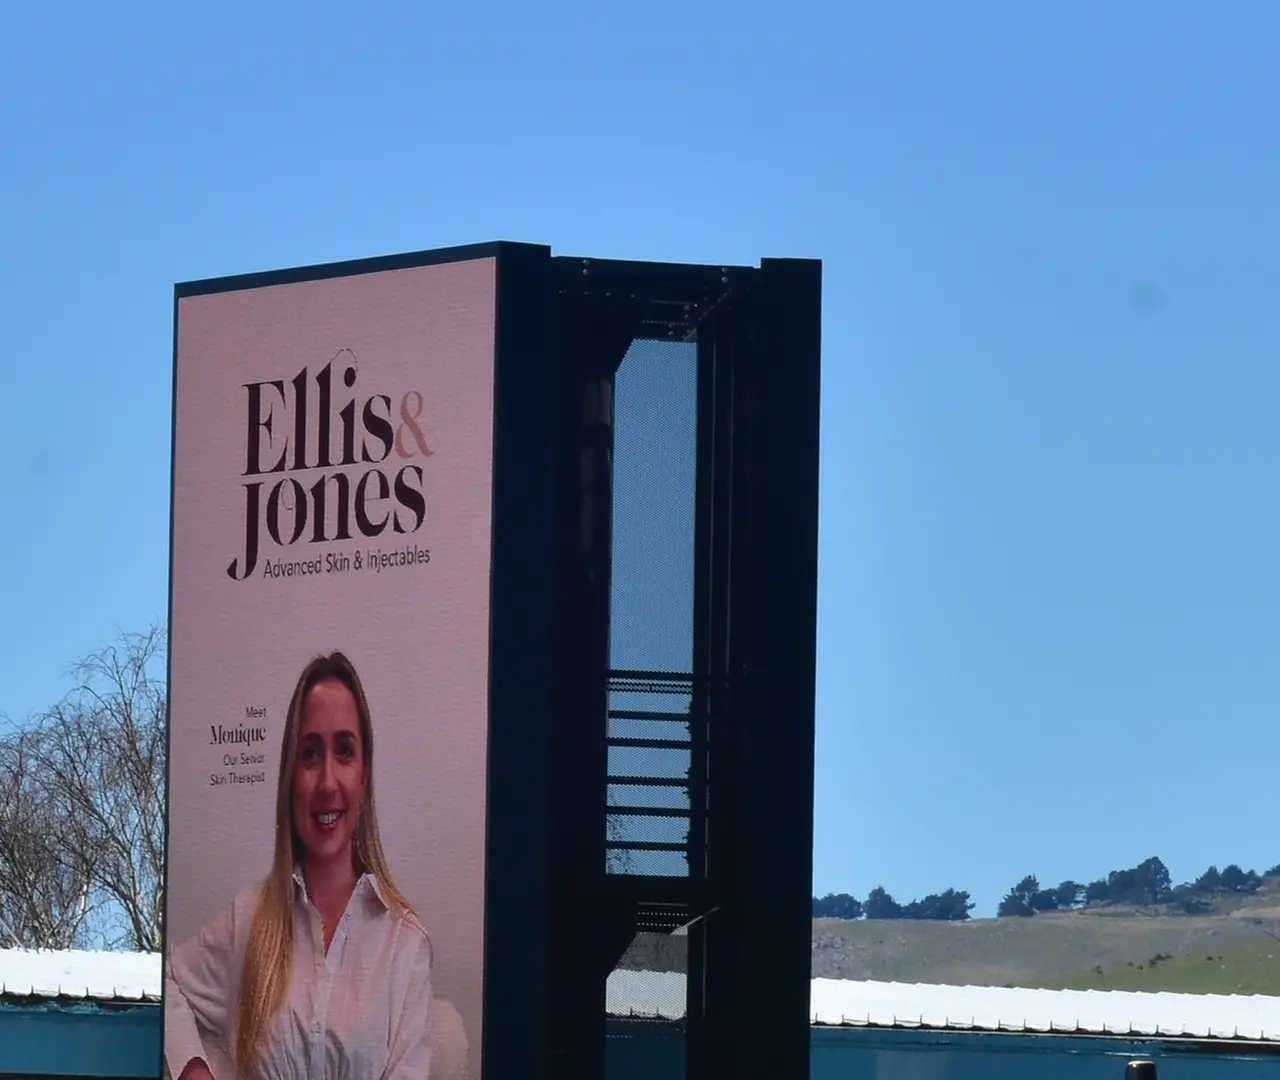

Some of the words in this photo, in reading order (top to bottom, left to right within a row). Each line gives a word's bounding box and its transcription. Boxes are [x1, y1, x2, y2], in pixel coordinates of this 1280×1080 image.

[227, 465, 426, 581] Jones
[263, 554, 321, 579] Advanced
[325, 551, 350, 573] Skin
[353, 550, 363, 571] &
[366, 545, 430, 574] Injectables
[245, 706, 267, 718] Meet
[210, 723, 267, 748] Monique
[223, 753, 238, 766] Our
[210, 773, 227, 786] Skin
[229, 772, 265, 785] Therapist
